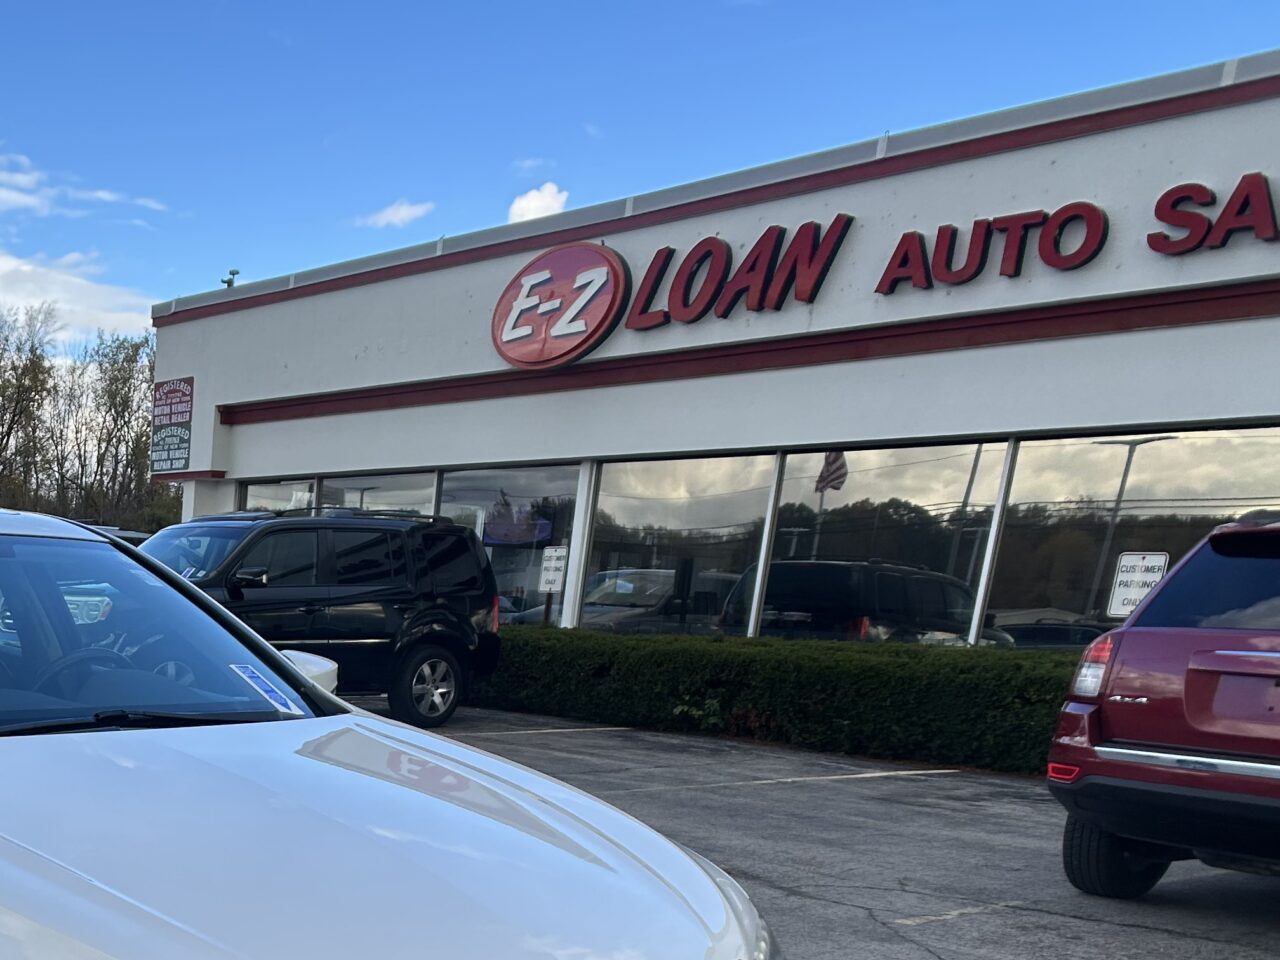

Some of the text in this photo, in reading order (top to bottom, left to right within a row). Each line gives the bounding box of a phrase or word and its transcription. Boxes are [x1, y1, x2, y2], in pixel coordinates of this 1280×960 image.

[502, 267, 609, 342] E-Z
[625, 213, 855, 330] LOAN
[874, 201, 1109, 295] AUTO
[155, 380, 191, 400] REGISTERED
[154, 401, 191, 416] MOTOR VEHICLE
[154, 412, 190, 425] RETAIL DEALER
[153, 426, 190, 443] REGISTERED
[152, 448, 189, 460] MOTOR VEHICLE
[153, 459, 186, 470] REPAIR SHOP
[1118, 579, 1157, 588] PARKING
